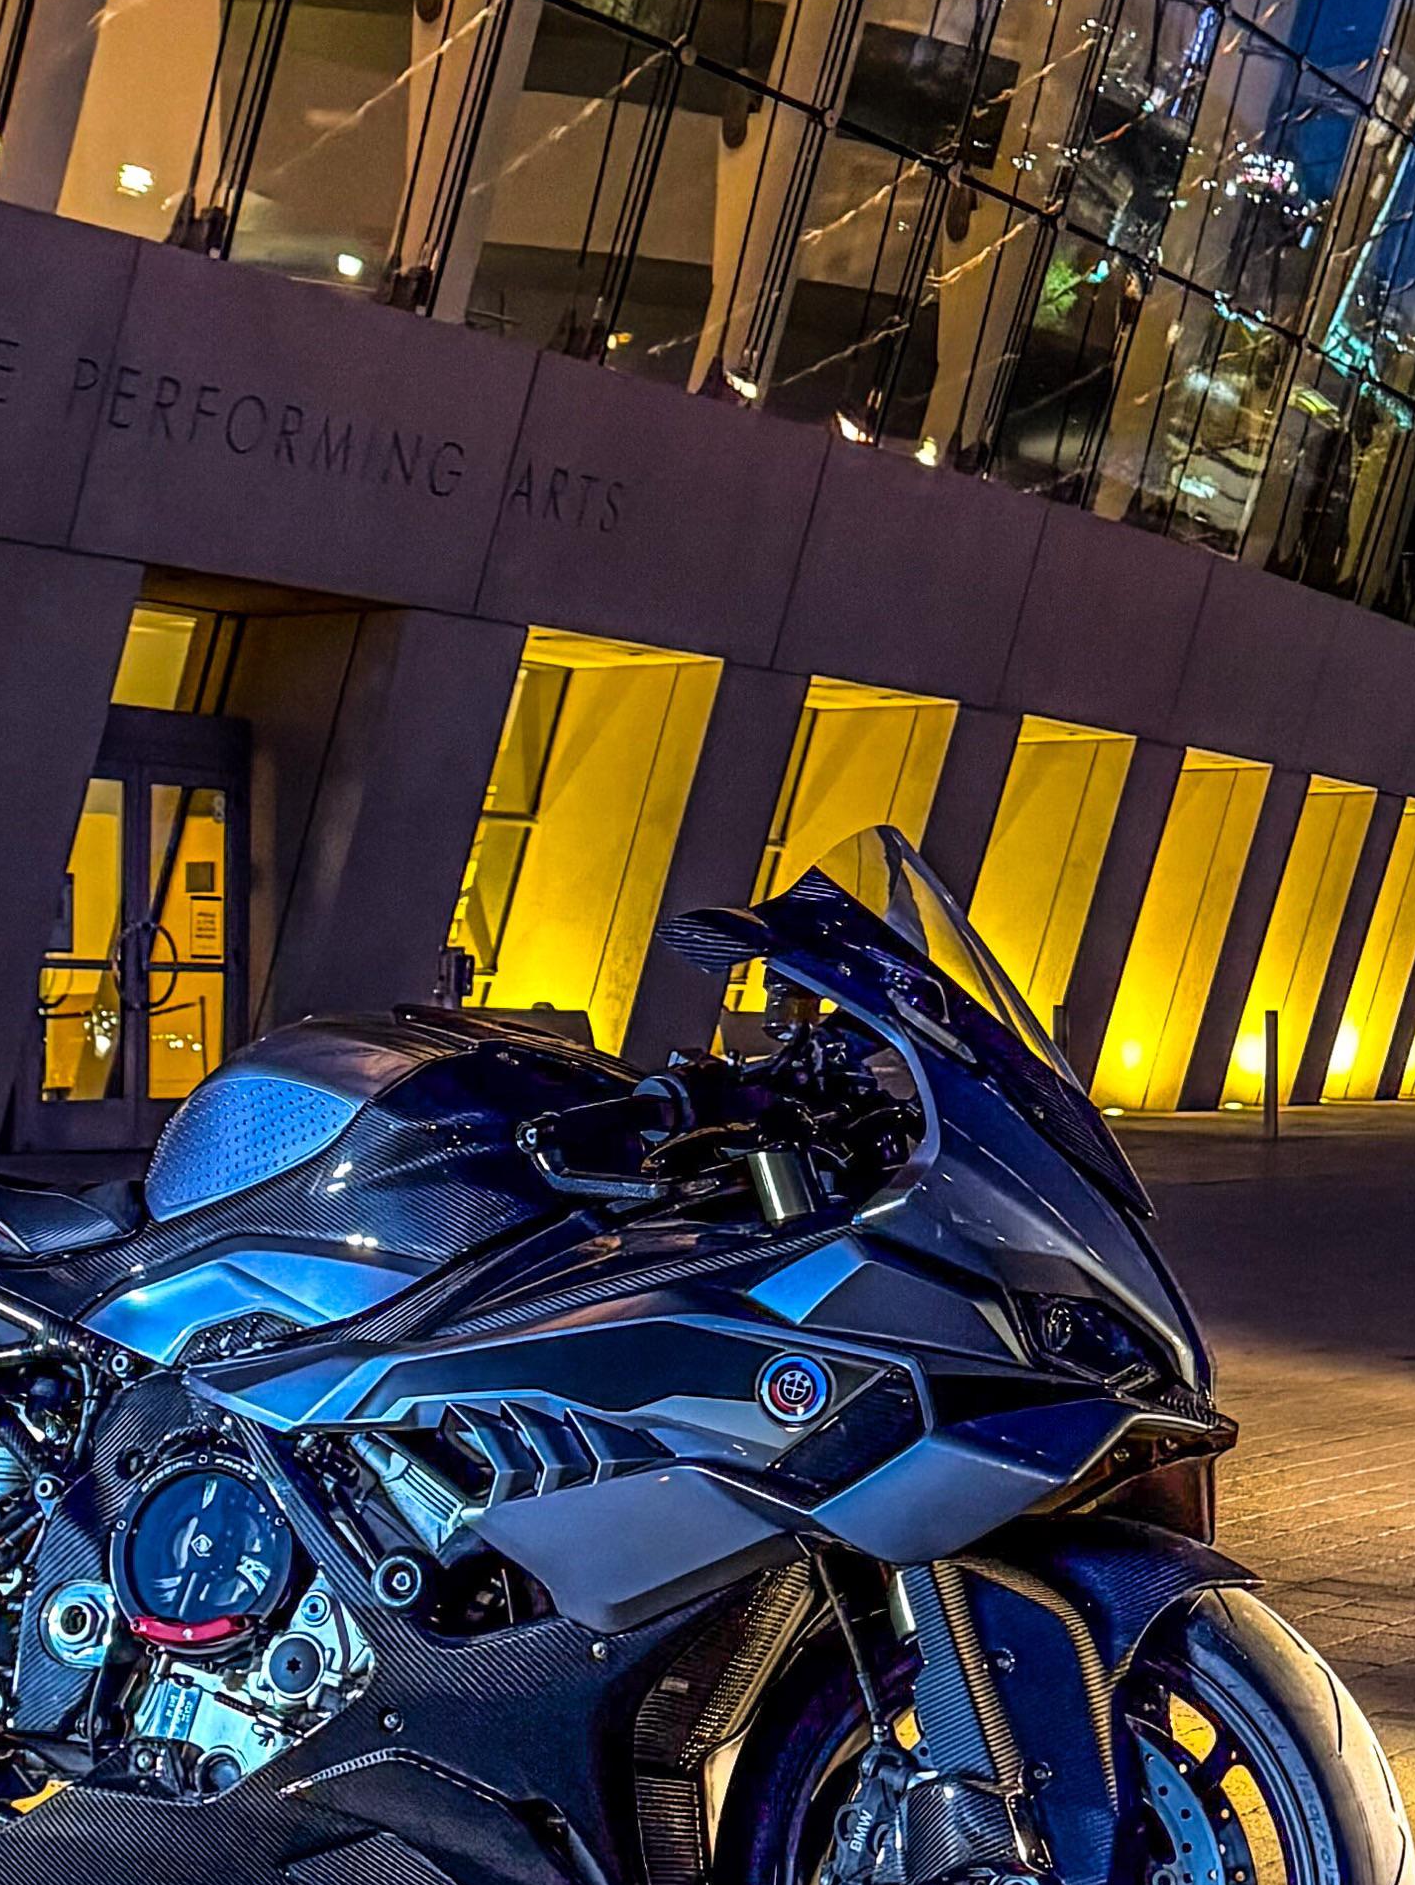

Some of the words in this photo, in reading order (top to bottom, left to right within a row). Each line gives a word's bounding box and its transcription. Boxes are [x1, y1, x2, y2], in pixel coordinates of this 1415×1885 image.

[66, 356, 464, 499] PERFORMING
[508, 461, 623, 533] ARTS
[849, 1809, 873, 1852] BMW
